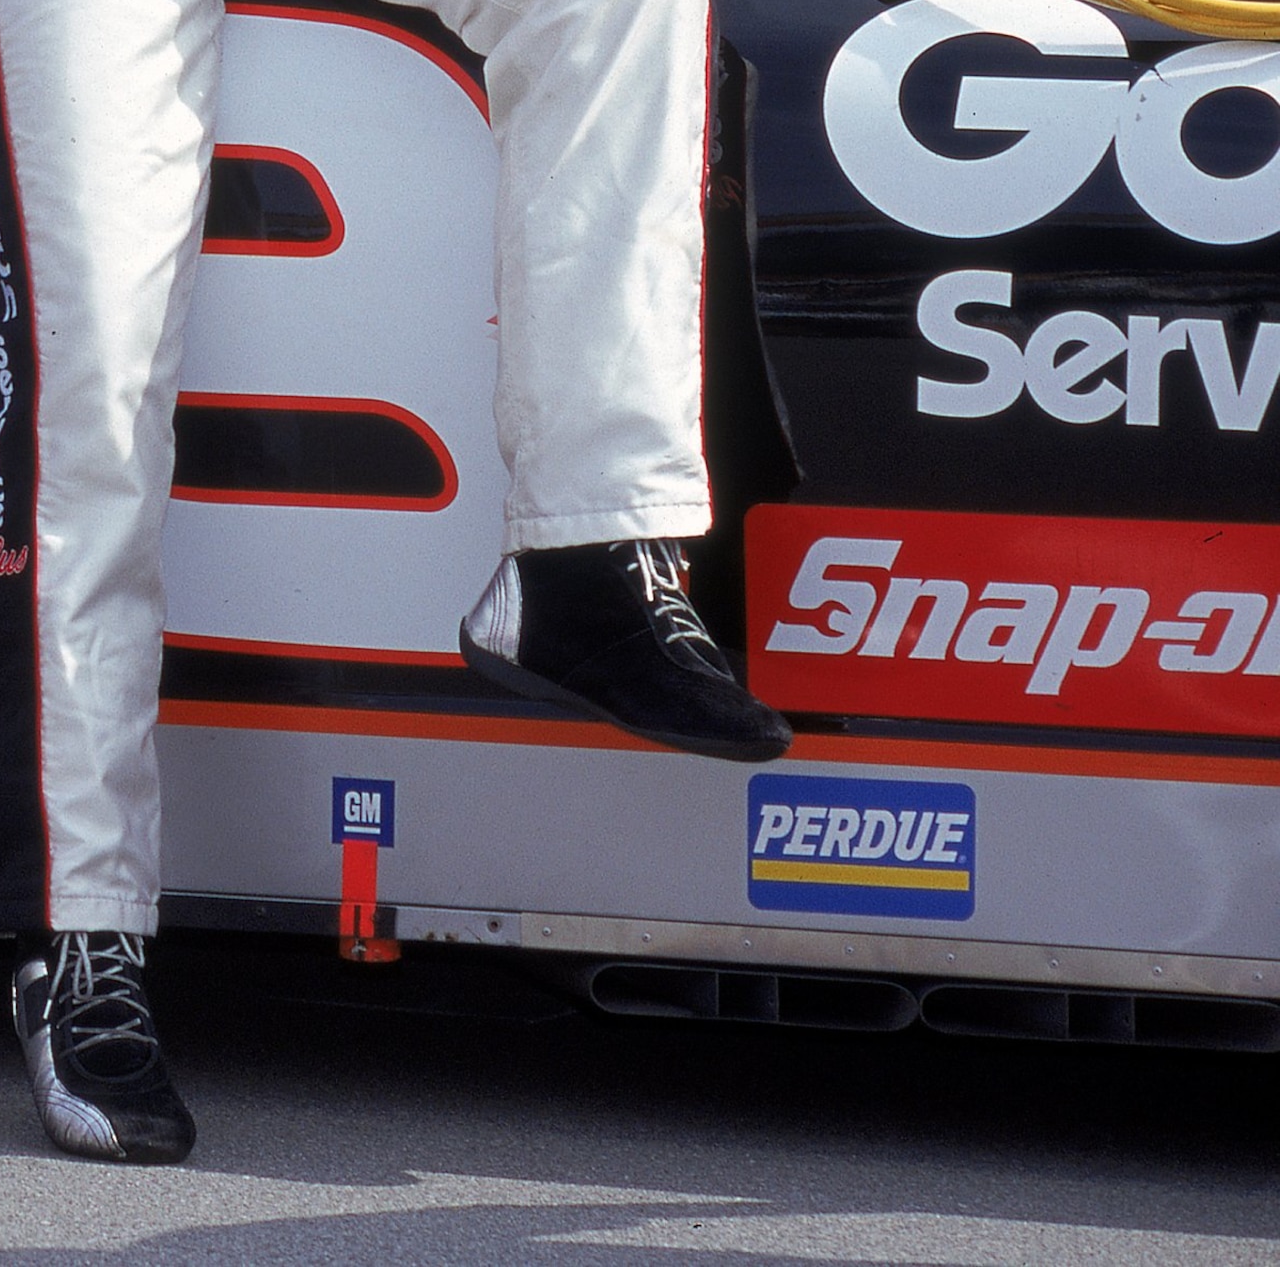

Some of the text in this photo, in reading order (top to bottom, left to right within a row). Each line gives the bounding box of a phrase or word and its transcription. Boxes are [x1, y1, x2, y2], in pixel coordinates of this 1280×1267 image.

[916, 268, 1280, 433] Serv
[341, 789, 382, 825] GM
[752, 803, 971, 865] PERDUE
